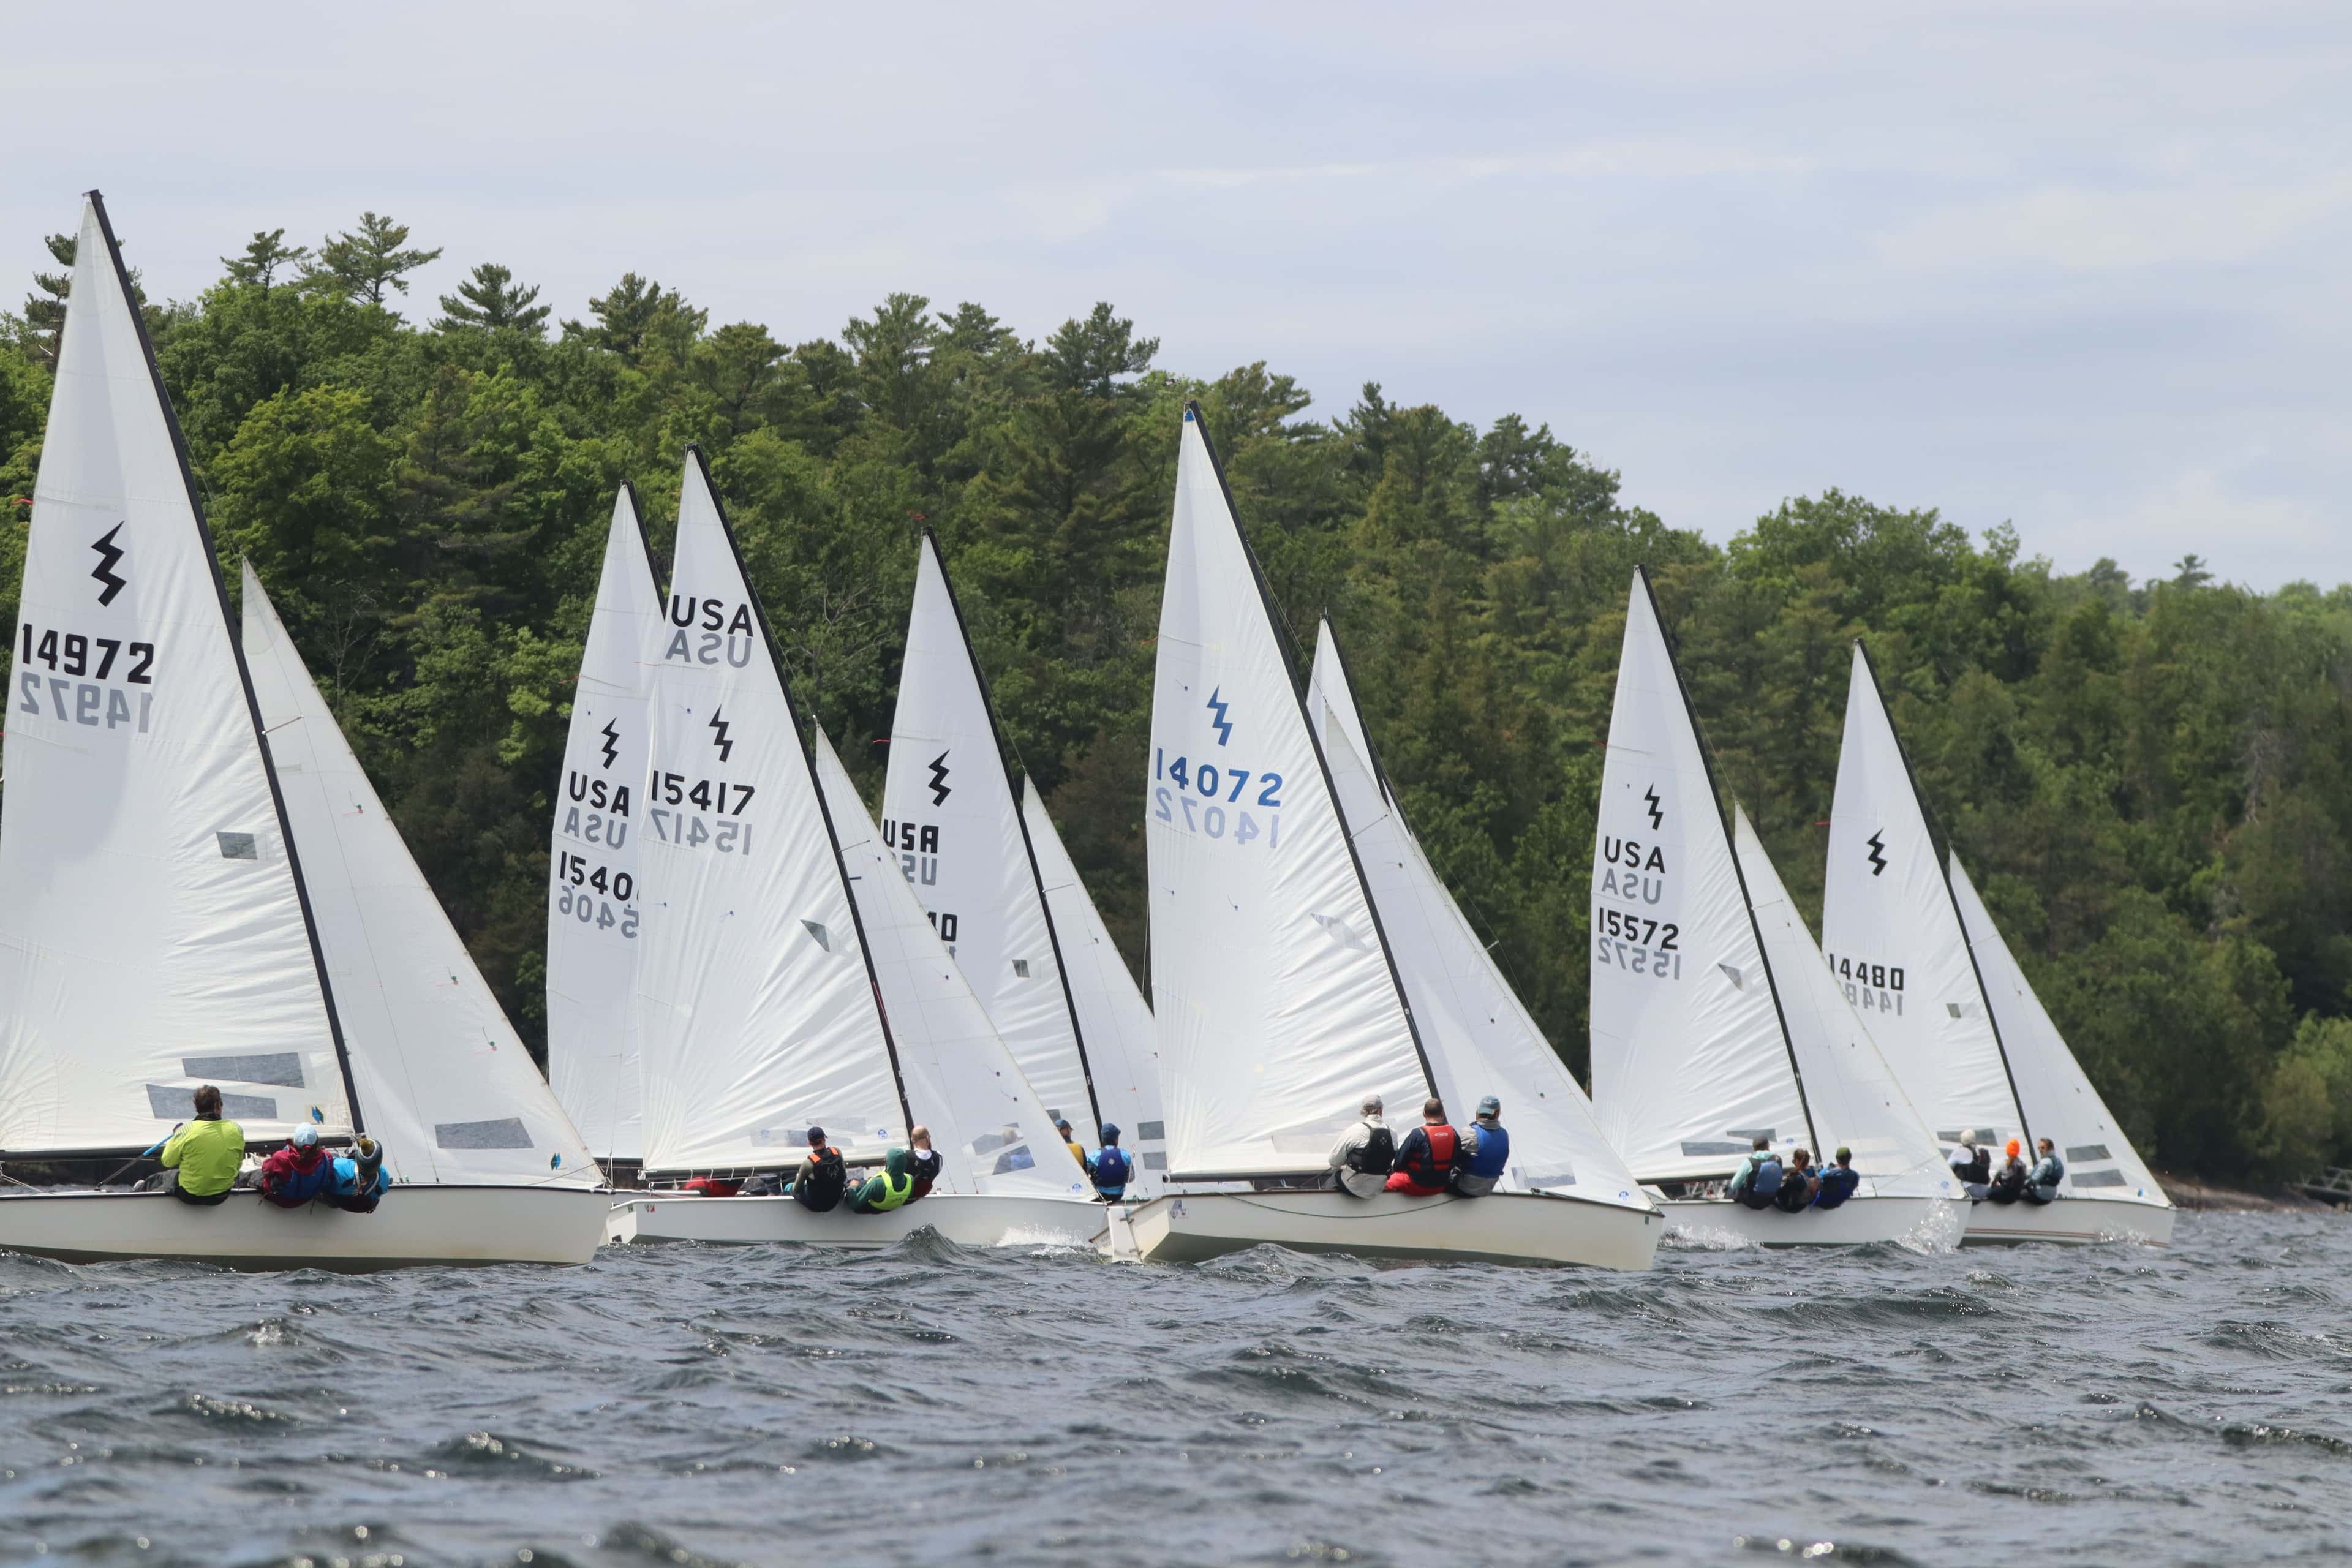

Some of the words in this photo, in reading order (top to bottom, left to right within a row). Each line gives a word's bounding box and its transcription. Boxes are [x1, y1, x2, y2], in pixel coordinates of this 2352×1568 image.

[671, 595, 754, 638] USA
[22, 623, 155, 685] 14972
[570, 771, 630, 818] USA
[651, 769, 756, 816] 15417
[1157, 747, 1283, 807] 14072
[883, 818, 939, 854] USA
[1604, 835, 1665, 874] USA
[560, 850, 639, 902] 1540
[1599, 907, 1679, 951] 15572
[1829, 953, 1904, 991] 14480
